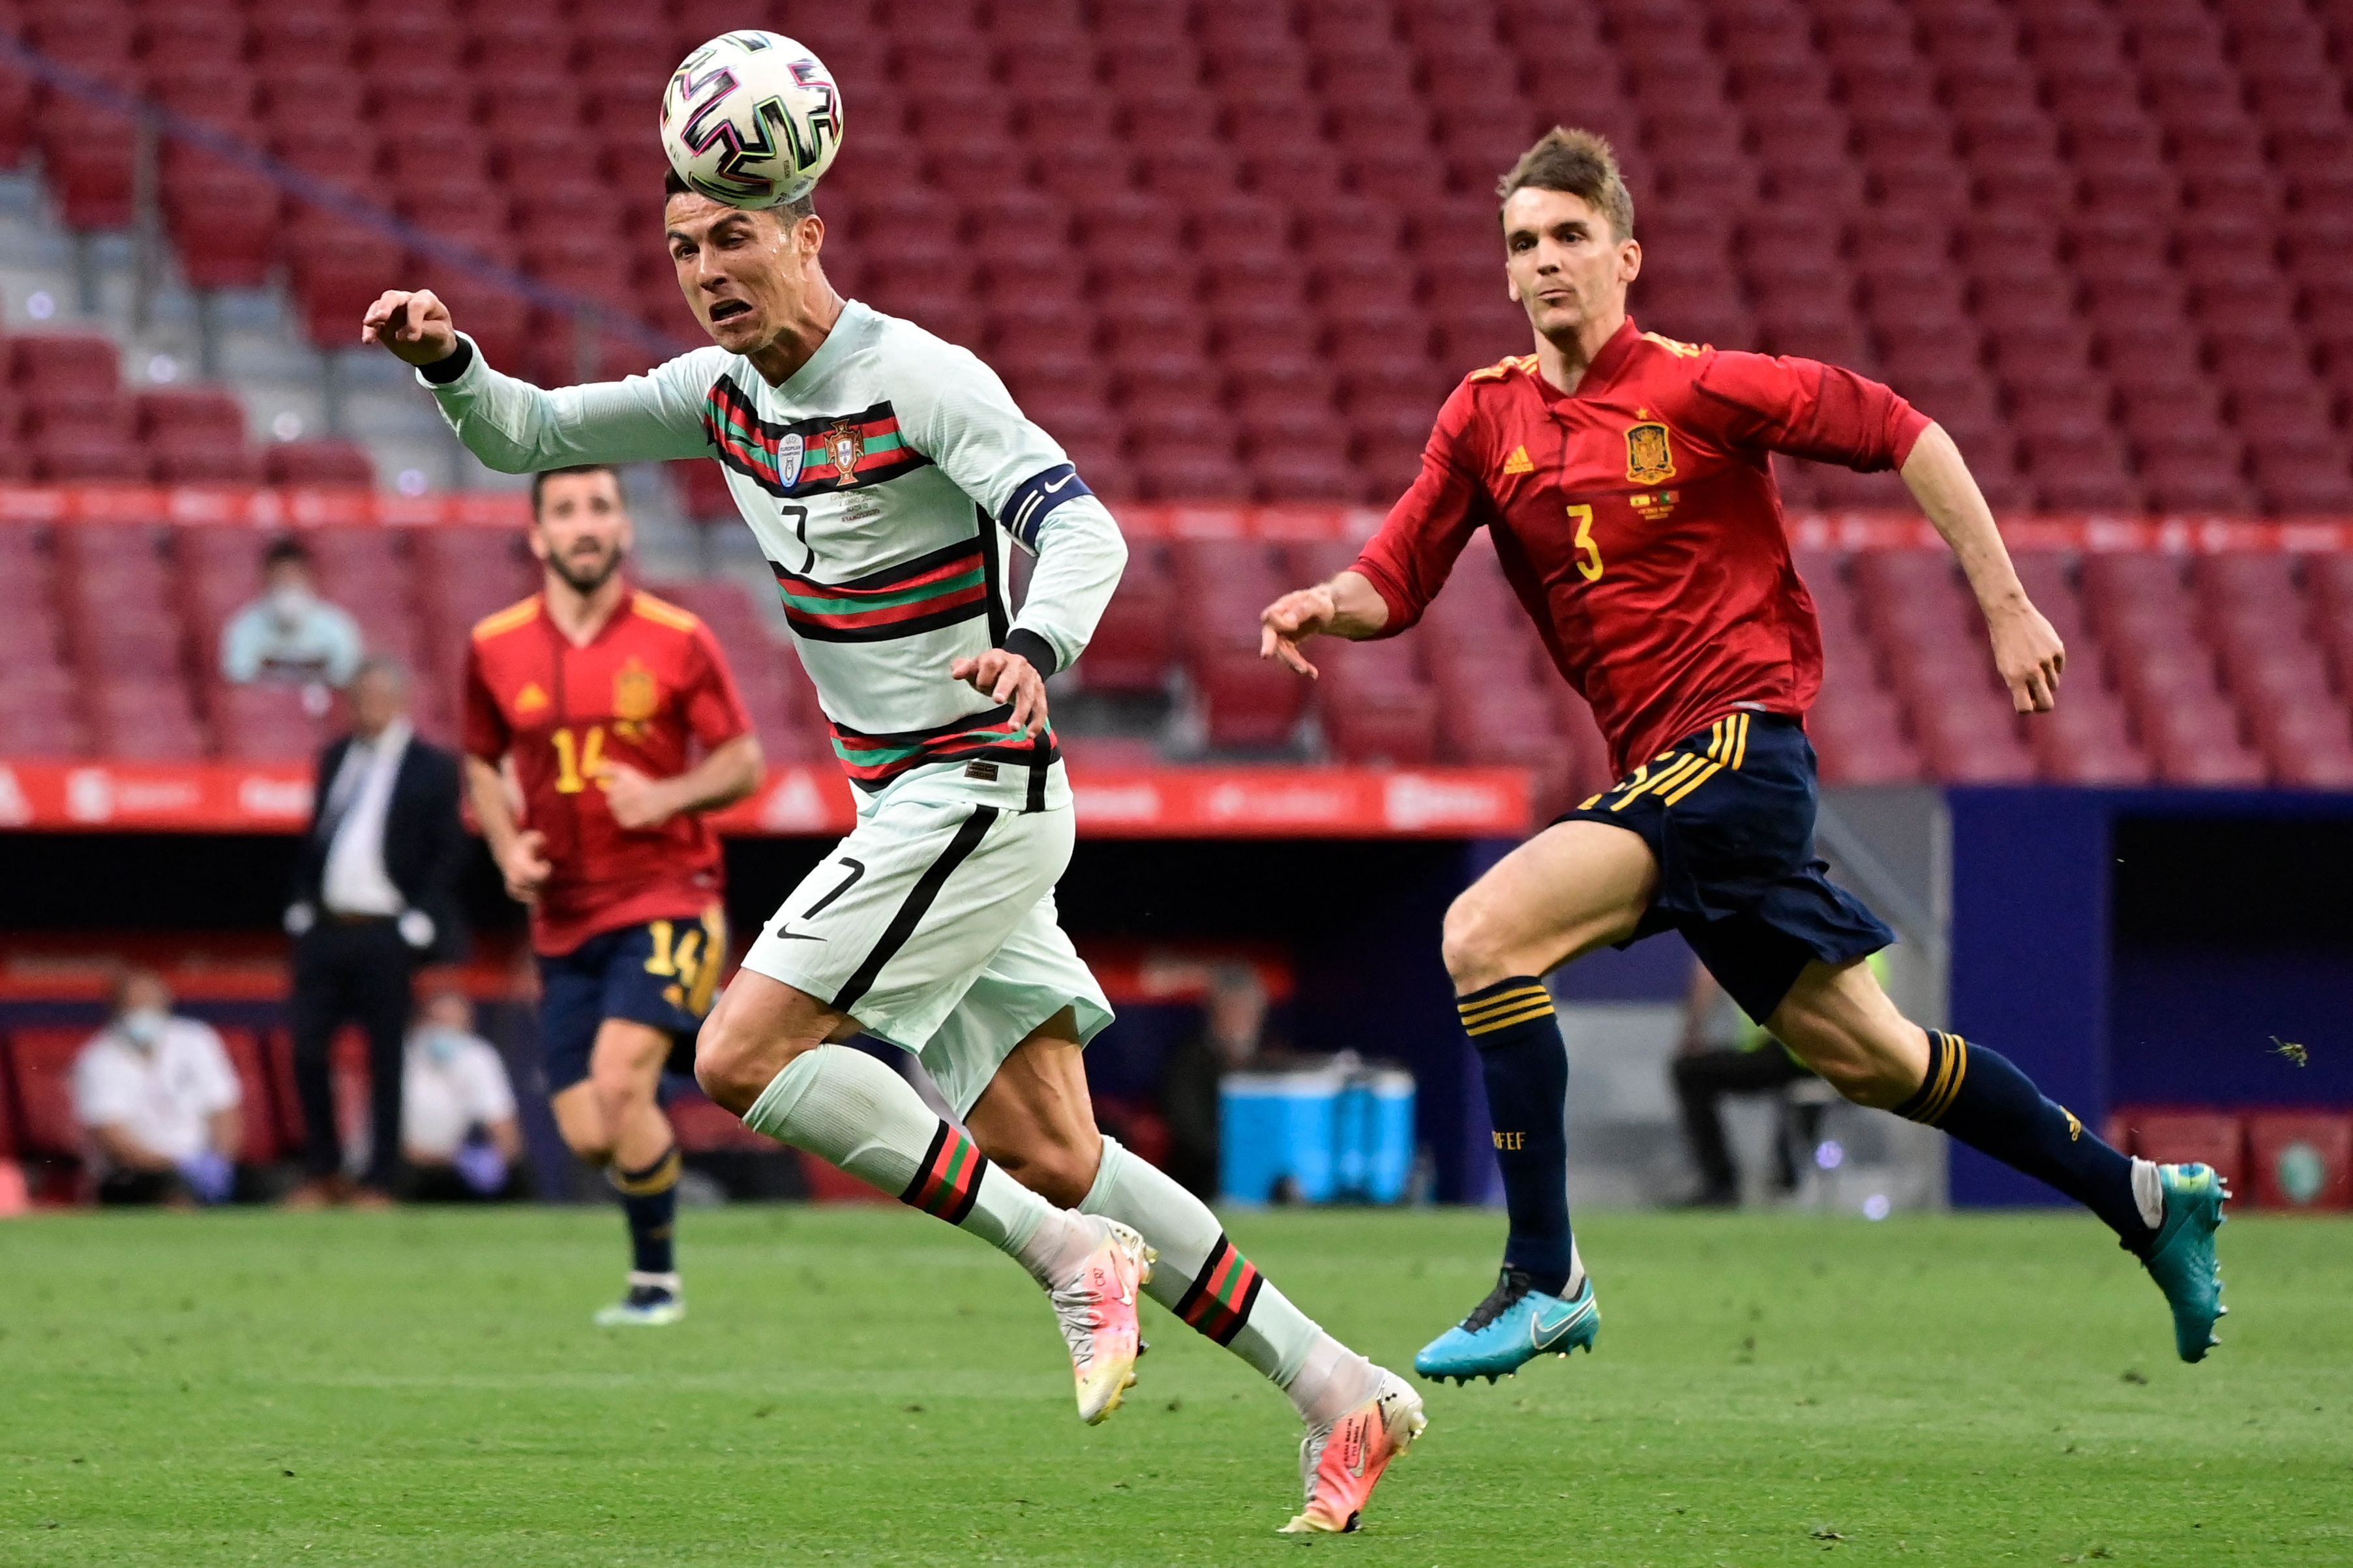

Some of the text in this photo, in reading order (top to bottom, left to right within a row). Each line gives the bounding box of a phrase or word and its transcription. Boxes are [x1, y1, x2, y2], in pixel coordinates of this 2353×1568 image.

[781, 506, 815, 574] 7
[1566, 504, 1603, 581] 3
[801, 857, 865, 921] 7
[644, 920, 702, 988] 14
[1093, 1267, 1107, 1287] CR7
